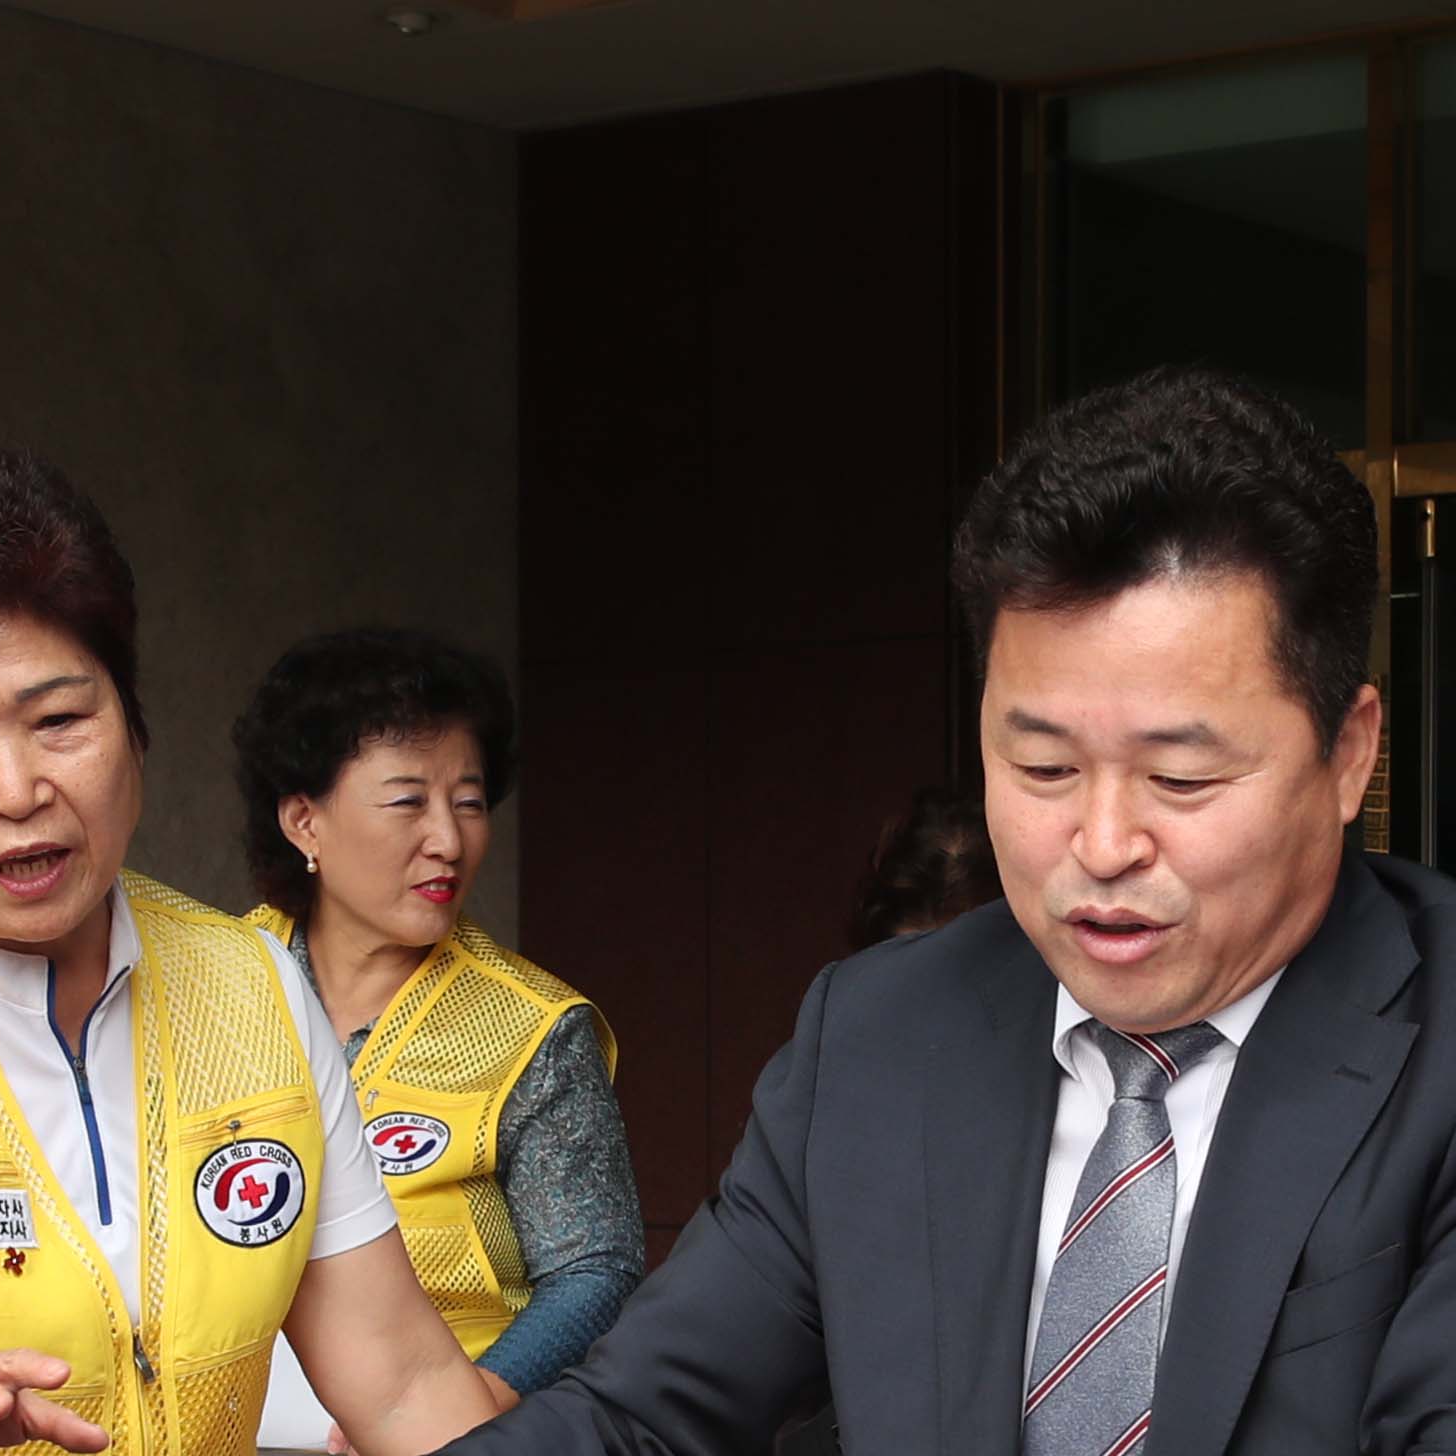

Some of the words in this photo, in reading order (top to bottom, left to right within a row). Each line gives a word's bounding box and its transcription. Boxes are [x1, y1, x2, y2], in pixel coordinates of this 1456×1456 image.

[200, 1154, 228, 1190] KOREAN
[230, 1146, 252, 1159] RED
[260, 1145, 293, 1168] CROSS
